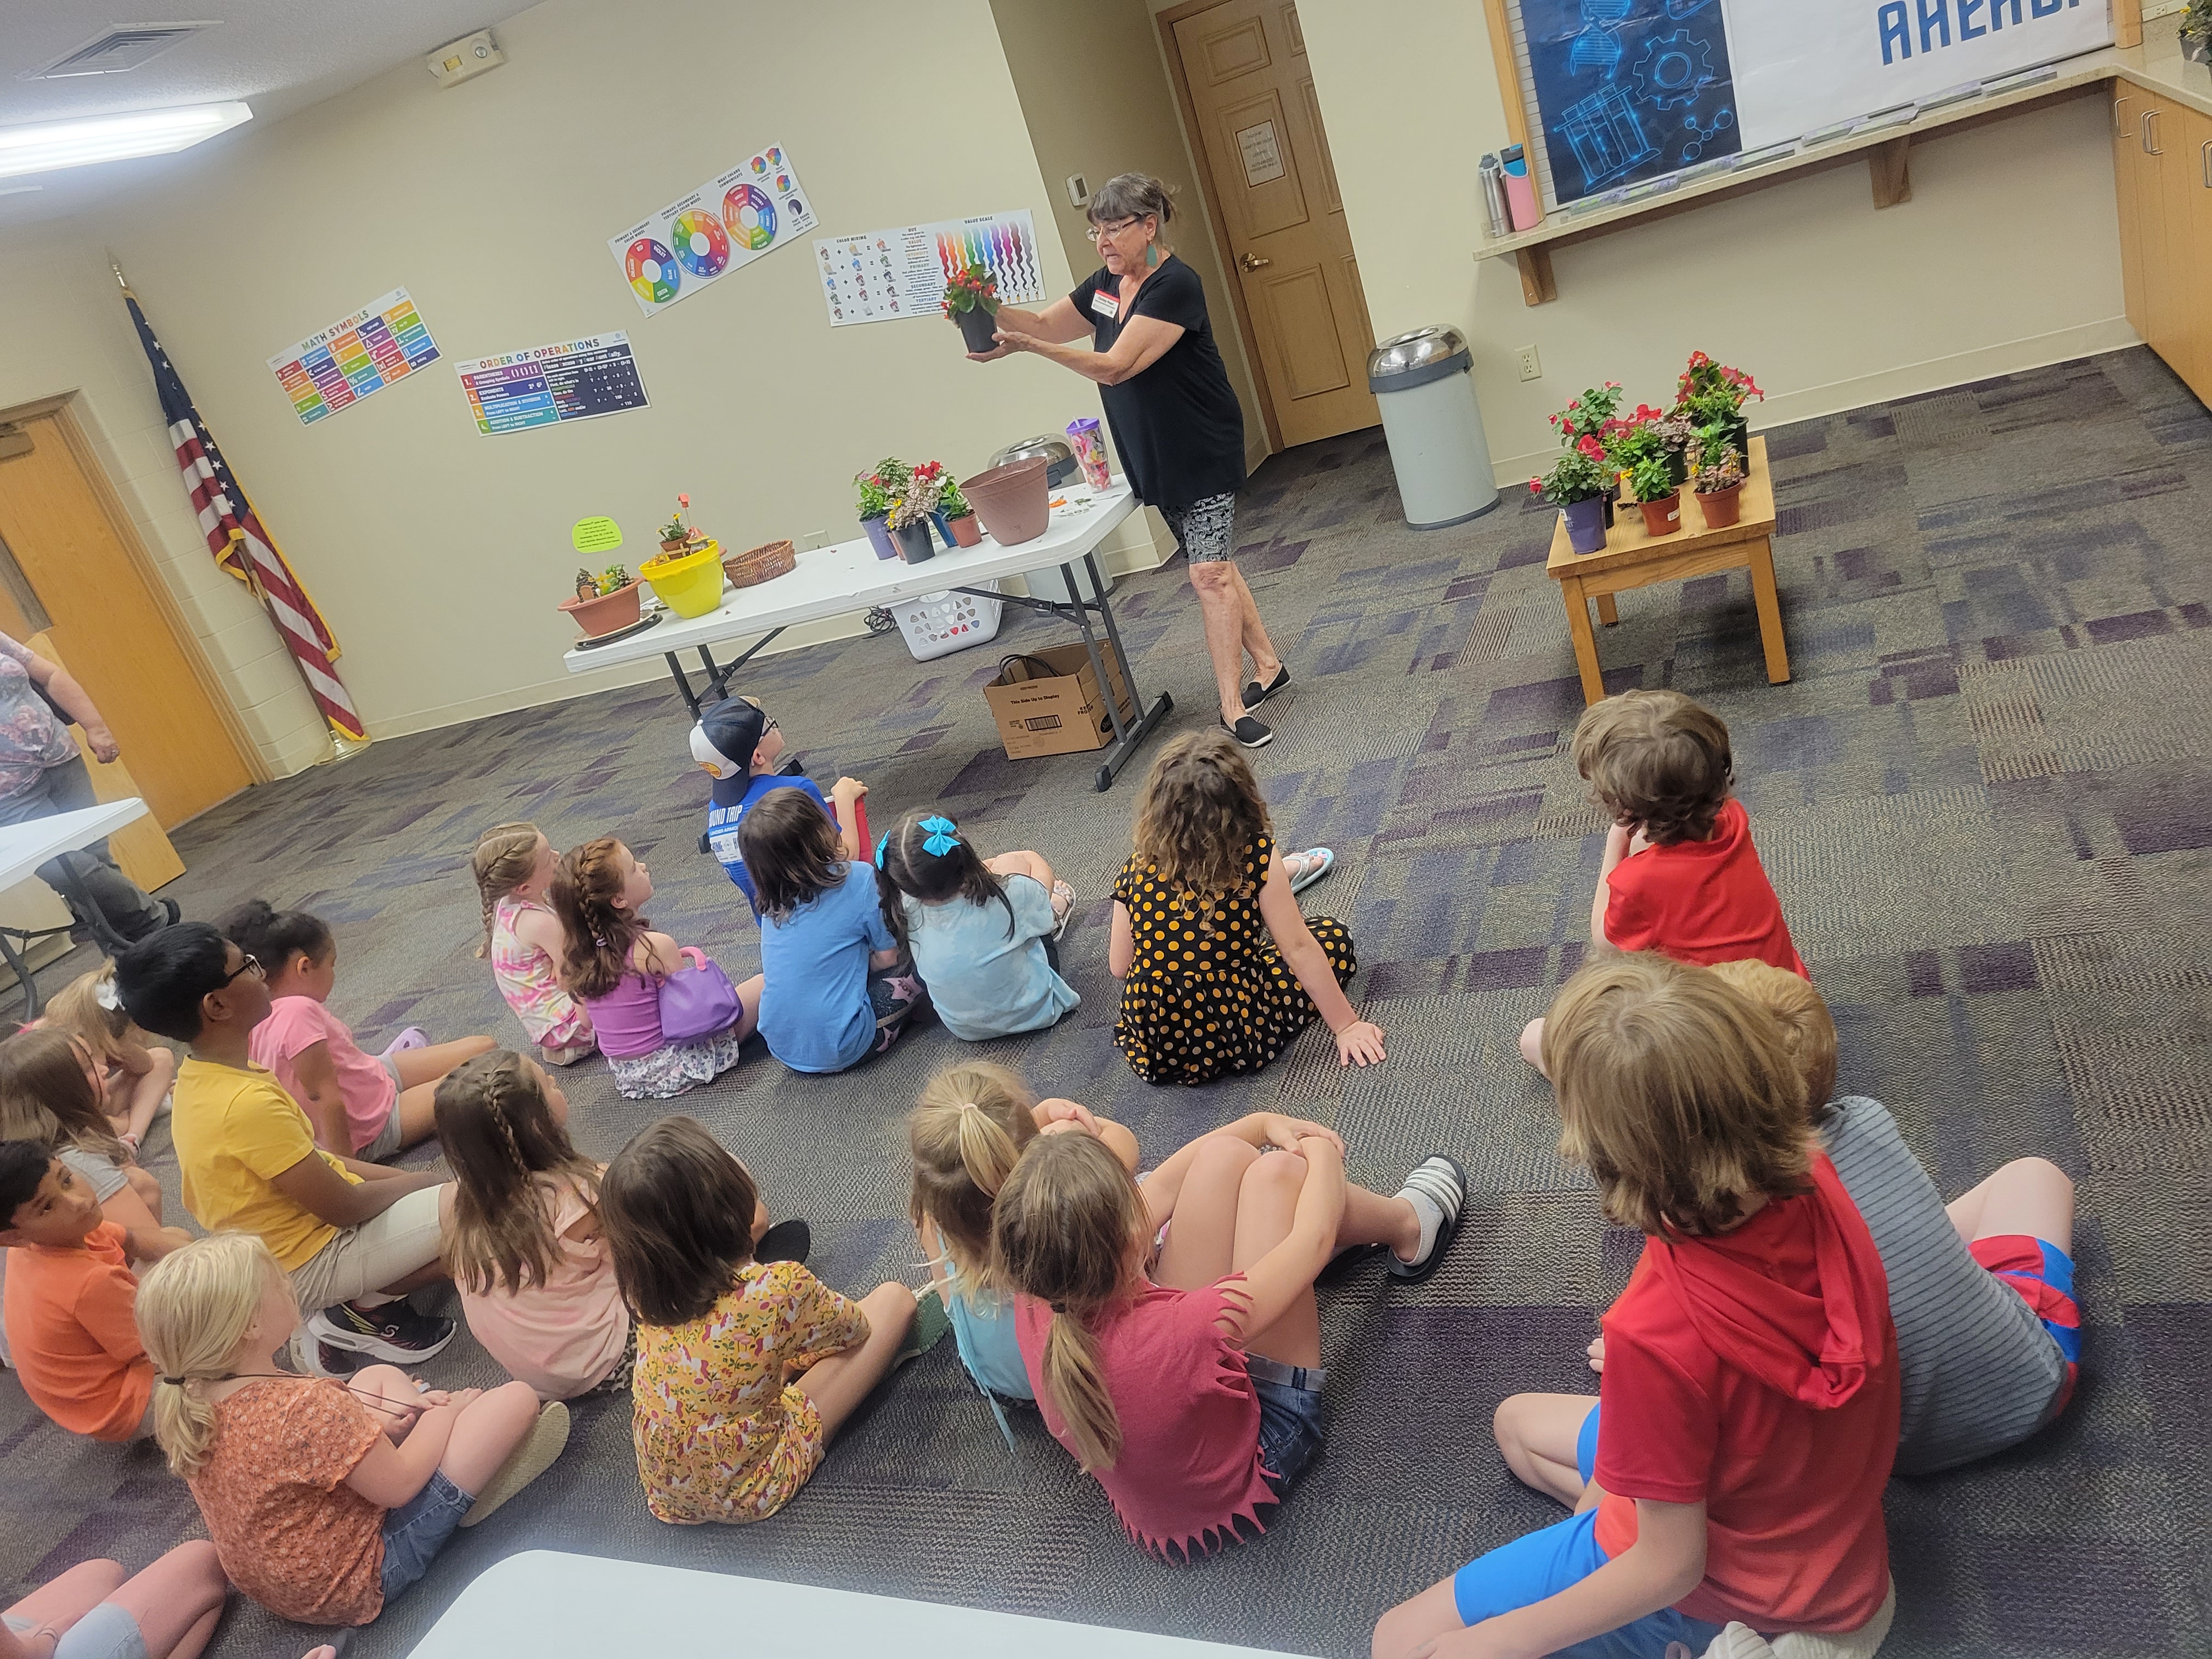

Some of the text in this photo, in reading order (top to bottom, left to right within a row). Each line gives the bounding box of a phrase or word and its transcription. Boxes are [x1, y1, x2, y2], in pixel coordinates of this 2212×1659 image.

[727, 168, 740, 178] COLORS
[719, 172, 742, 188] COMMUNICATE
[677, 195, 694, 207] SECONDARY
[663, 210, 679, 220] TERTIARY
[690, 196, 701, 205] WHEEL
[615, 234, 629, 243] PRIMARY
[633, 221, 650, 233] SECONDARY
[653, 245, 667, 258] VIOLET
[301, 310, 369, 351] MATH SYMBOLS
[478, 355, 514, 369] ORDER
[515, 352, 531, 362] OF
[532, 338, 600, 359] OPERATIONS
[607, 350, 623, 359] Sally.
[473, 370, 503, 380] PARENTHESES
[478, 387, 504, 396] EXPONENTS
[483, 400, 517, 411] MULTIPLICATION
[521, 396, 541, 404] DIVISION
[513, 411, 544, 421] SUBTRACTION
[1077, 705, 1094, 715] FROZEN
[726, 805, 743, 823] TRIP
